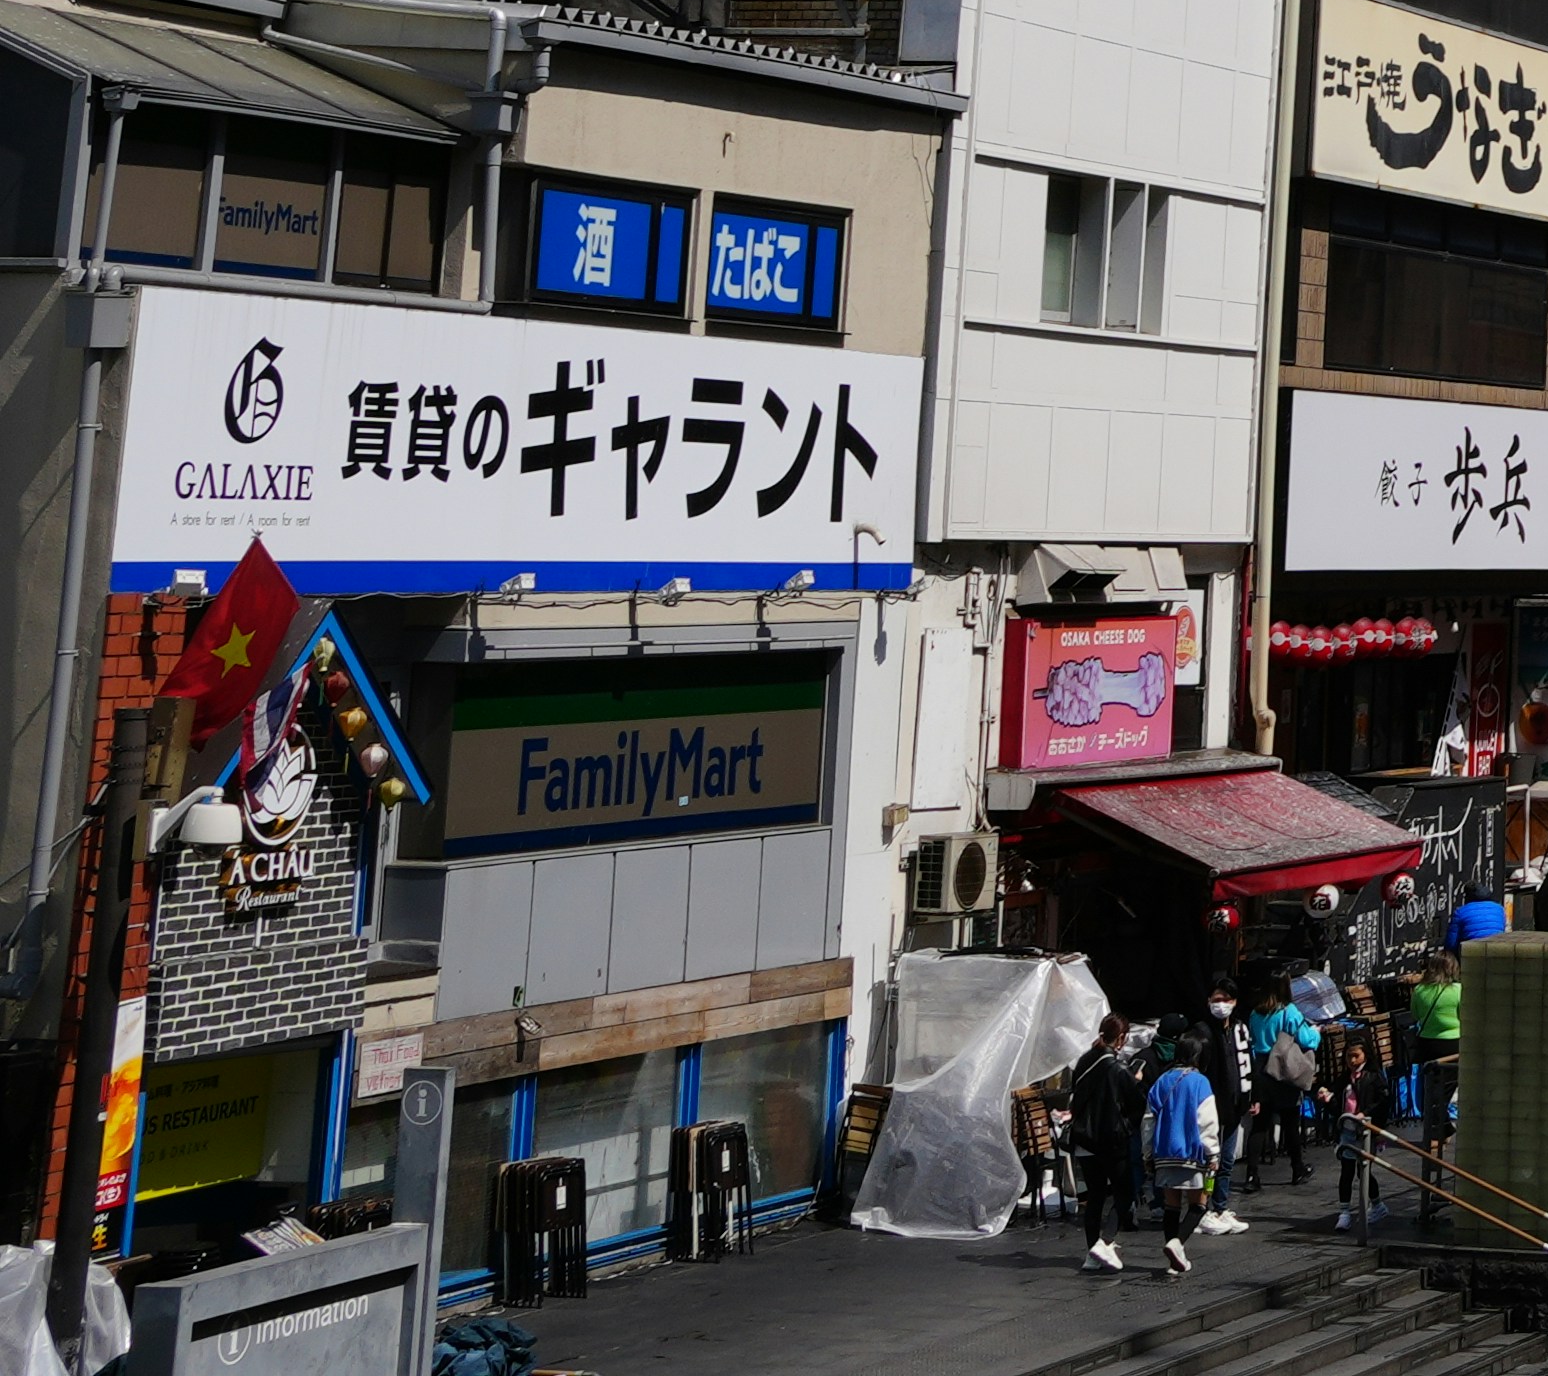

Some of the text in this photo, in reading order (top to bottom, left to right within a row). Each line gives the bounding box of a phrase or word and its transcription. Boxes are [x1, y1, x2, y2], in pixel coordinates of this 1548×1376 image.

[1323, 55, 1407, 113] 江戸焼
[1366, 33, 1547, 195] うなぎ
[572, 202, 616, 288] 酒
[712, 222, 802, 305] たばこ
[341, 359, 877, 522] 賃貸のギャラント
[175, 461, 313, 502] GALAXIE
[1374, 426, 1532, 546] 餃子 歩兵
[182, 513, 201, 526] store
[205, 512, 217, 526] for
[221, 513, 235, 526] rent
[258, 514, 277, 526] room
[282, 513, 292, 526] for
[296, 514, 311, 526] rent
[1060, 627, 1146, 647] OSAKA CHEESE DOG
[1097, 726, 1148, 751] チーズドッグ
[517, 723, 766, 818] FamilyMart
[235, 884, 301, 912] Restaurant
[162, 1095, 259, 1132] RESTAURANT
